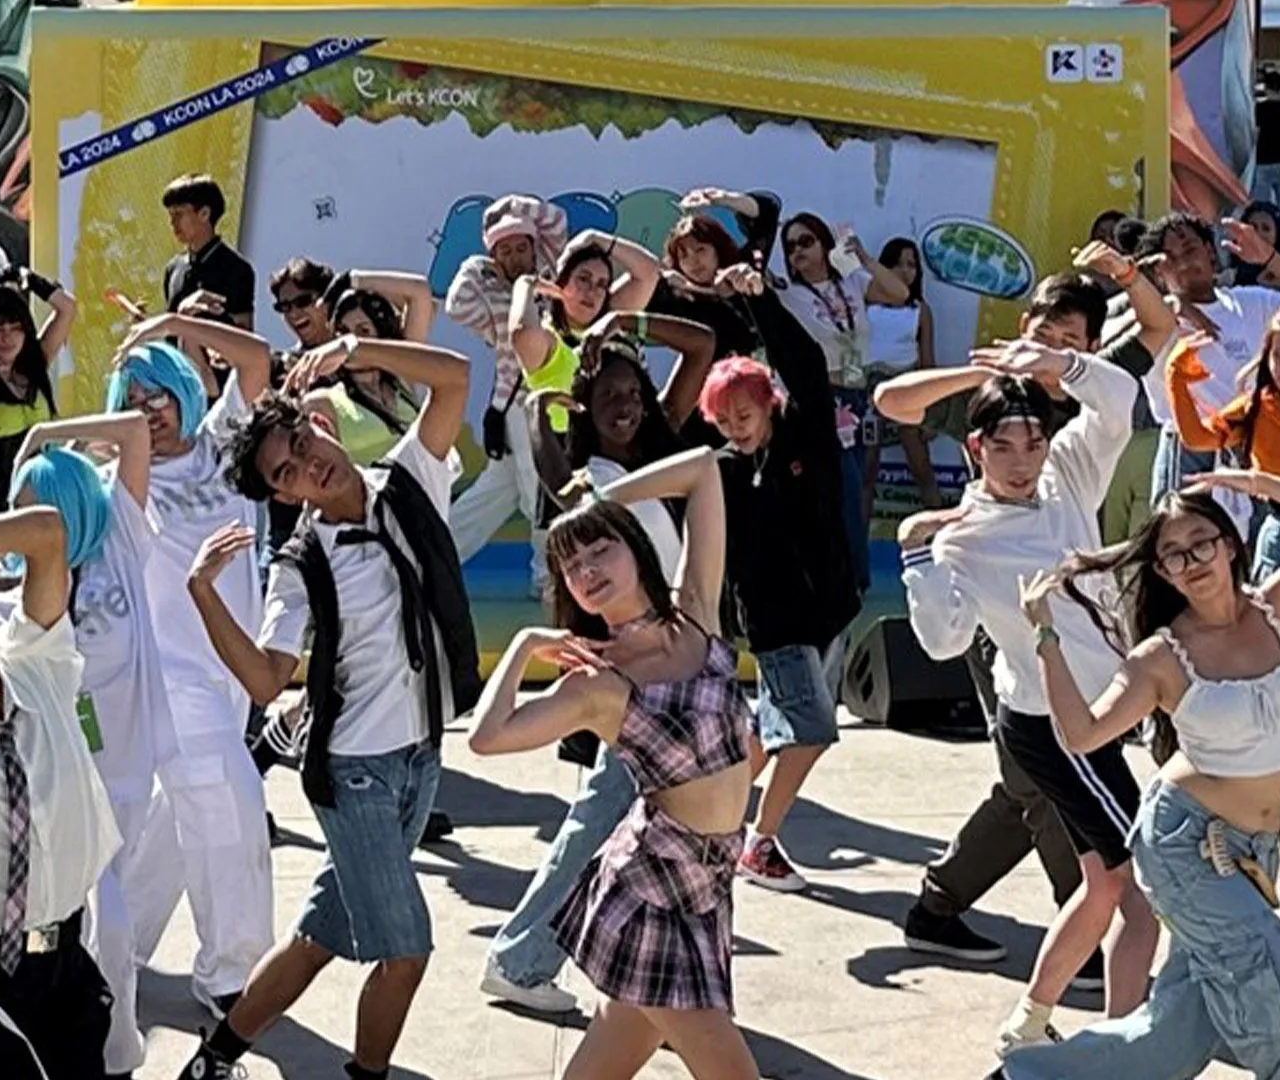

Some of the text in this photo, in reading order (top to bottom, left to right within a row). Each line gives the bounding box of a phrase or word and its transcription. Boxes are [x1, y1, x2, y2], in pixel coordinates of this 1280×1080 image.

[163, 69, 276, 127] KCON LA 2024
[427, 86, 481, 108] KCON
[80, 134, 122, 162] 2024
